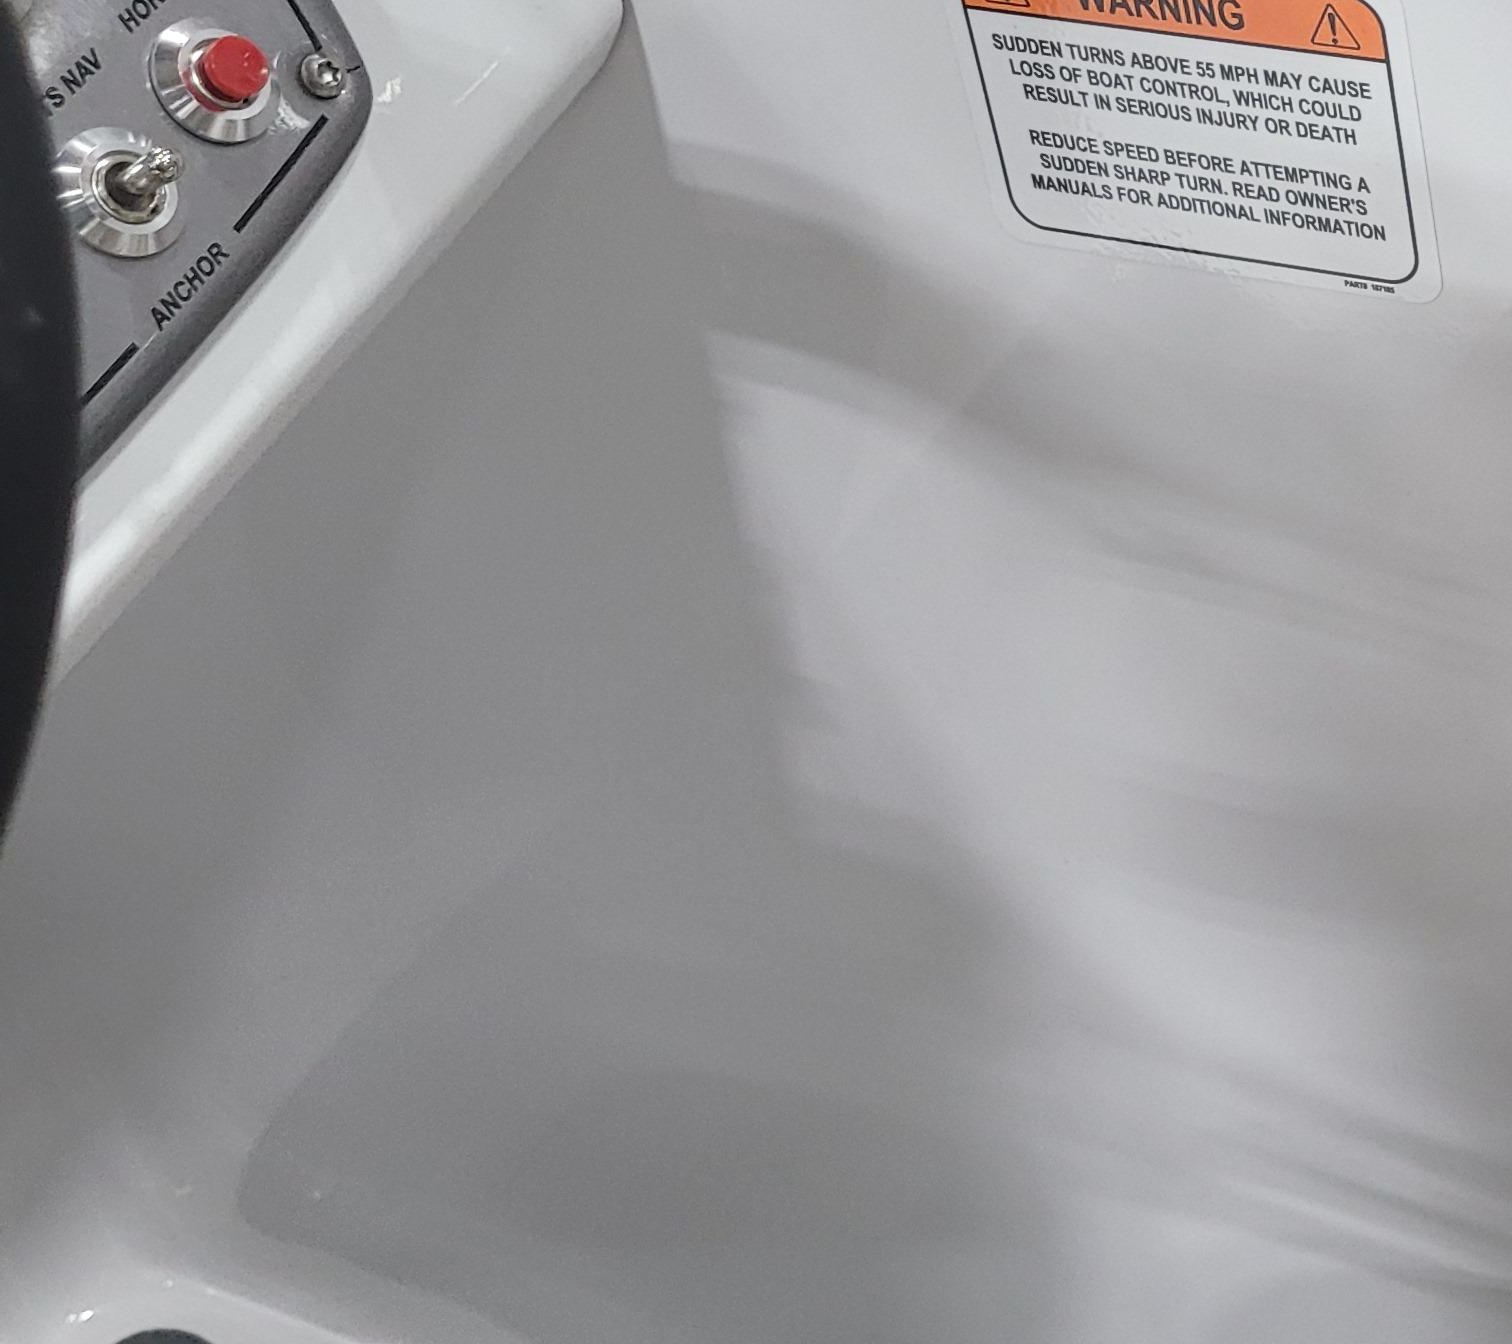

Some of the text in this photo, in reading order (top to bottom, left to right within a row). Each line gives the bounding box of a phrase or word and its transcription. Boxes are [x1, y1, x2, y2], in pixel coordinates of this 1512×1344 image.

[59, 47, 103, 96] NAV
[991, 33, 1372, 99] SUDDEN TURNS ABOVE 55 MPH MAY CAUSE
[1028, 128, 1371, 193] REDUCE SPEED BEFORE ATTEMPTING A
[150, 242, 230, 332] ANCHOR
